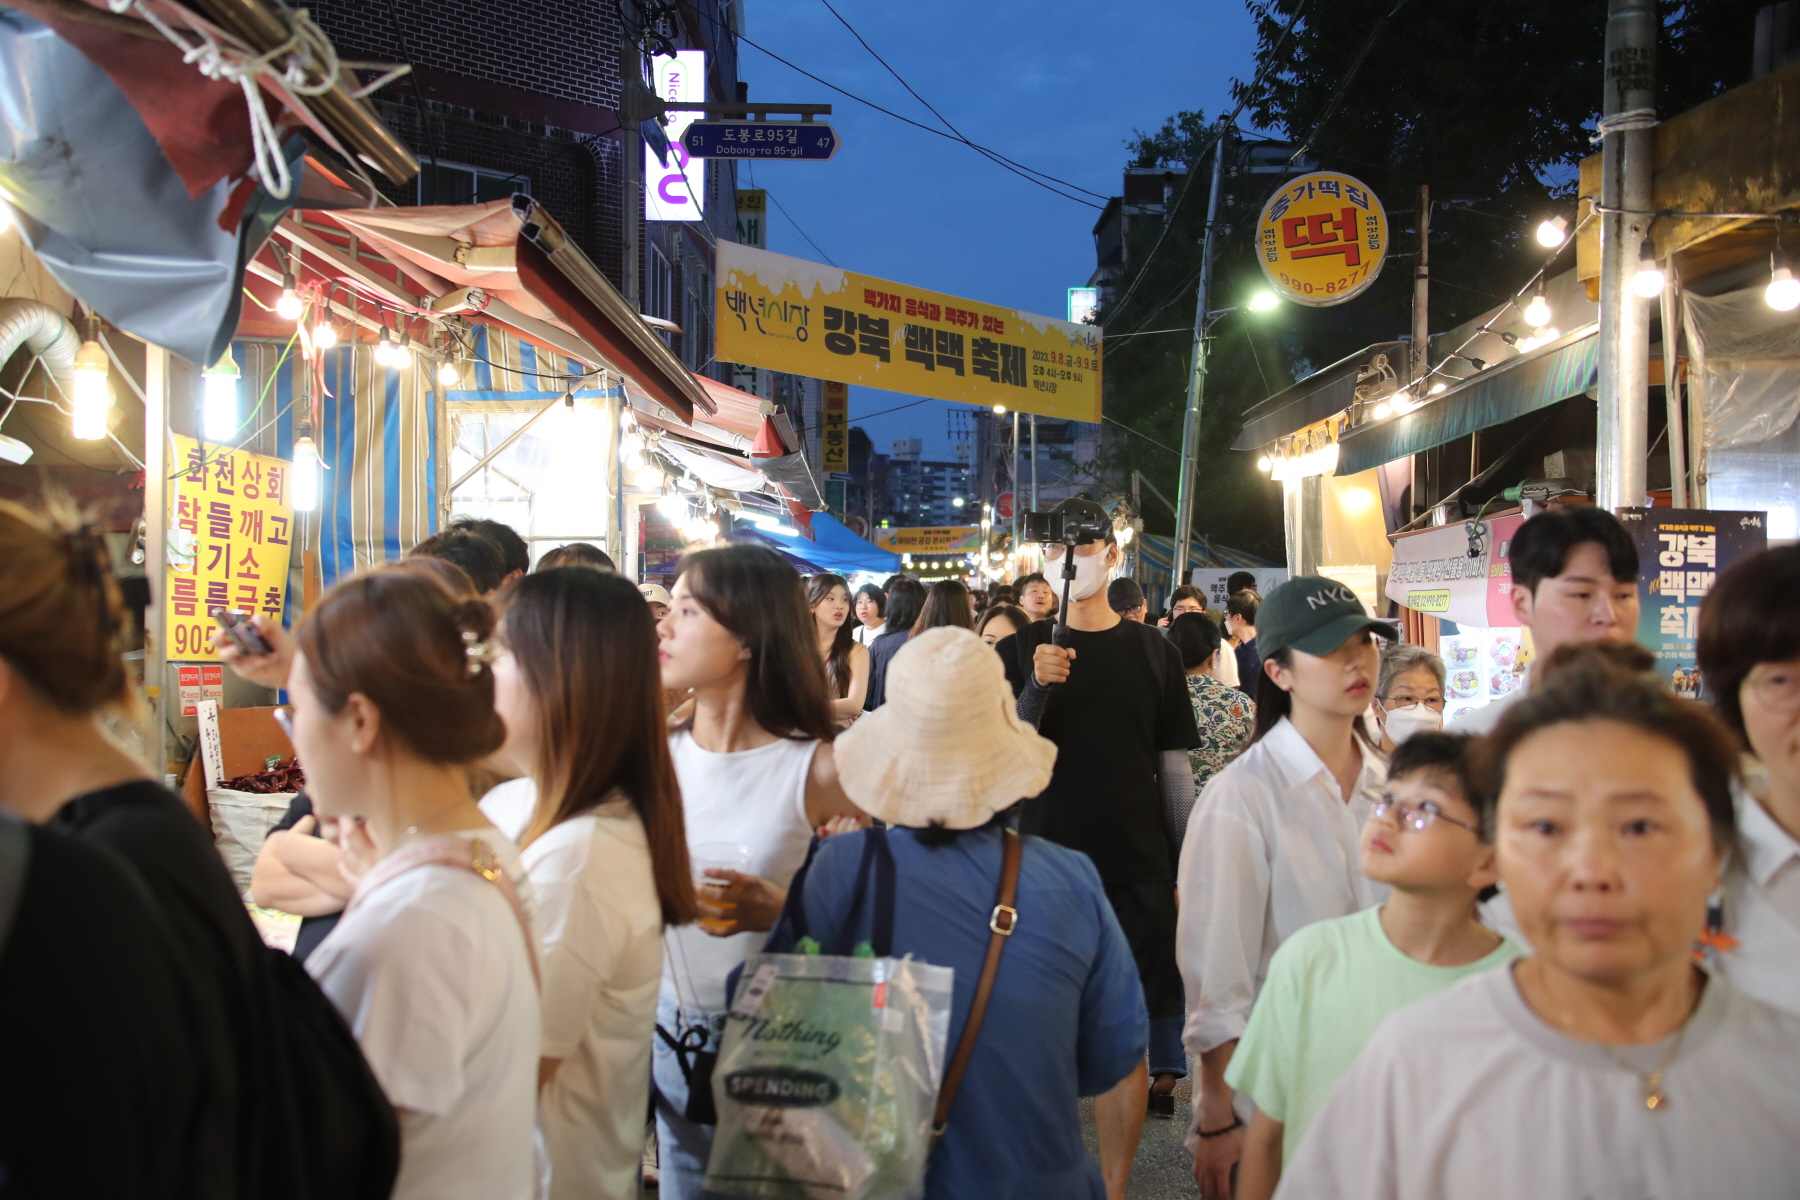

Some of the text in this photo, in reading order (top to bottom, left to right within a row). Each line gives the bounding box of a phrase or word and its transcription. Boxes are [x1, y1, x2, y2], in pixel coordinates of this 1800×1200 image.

[692, 136, 704, 146] 51
[722, 128, 797, 144] 도봉로95길
[817, 138, 830, 148] 47
[716, 145, 803, 158] Dobong-ro 95-gil
[1269, 180, 1370, 223] 종가떡집
[1282, 207, 1361, 267] 떡
[1280, 259, 1371, 294] 990-8277
[725, 290, 810, 342] 백년시장
[905, 298, 941, 322] 음식과
[945, 306, 979, 330] 맥주가
[982, 314, 1004, 335] 있는
[823, 305, 891, 363] 강북
[904, 323, 965, 378] 백맥
[971, 337, 1027, 388] 축제
[1033, 365, 1045, 376] 오후
[1073, 373, 1083, 383] 9시
[1033, 379, 1058, 394] 백년시장
[1659, 534, 1716, 568] 강북
[1210, 584, 1225, 594] 맥주
[1306, 586, 1357, 611] NYC
[741, 1016, 841, 1055] Nothing
[731, 1075, 830, 1098] SPENDING
